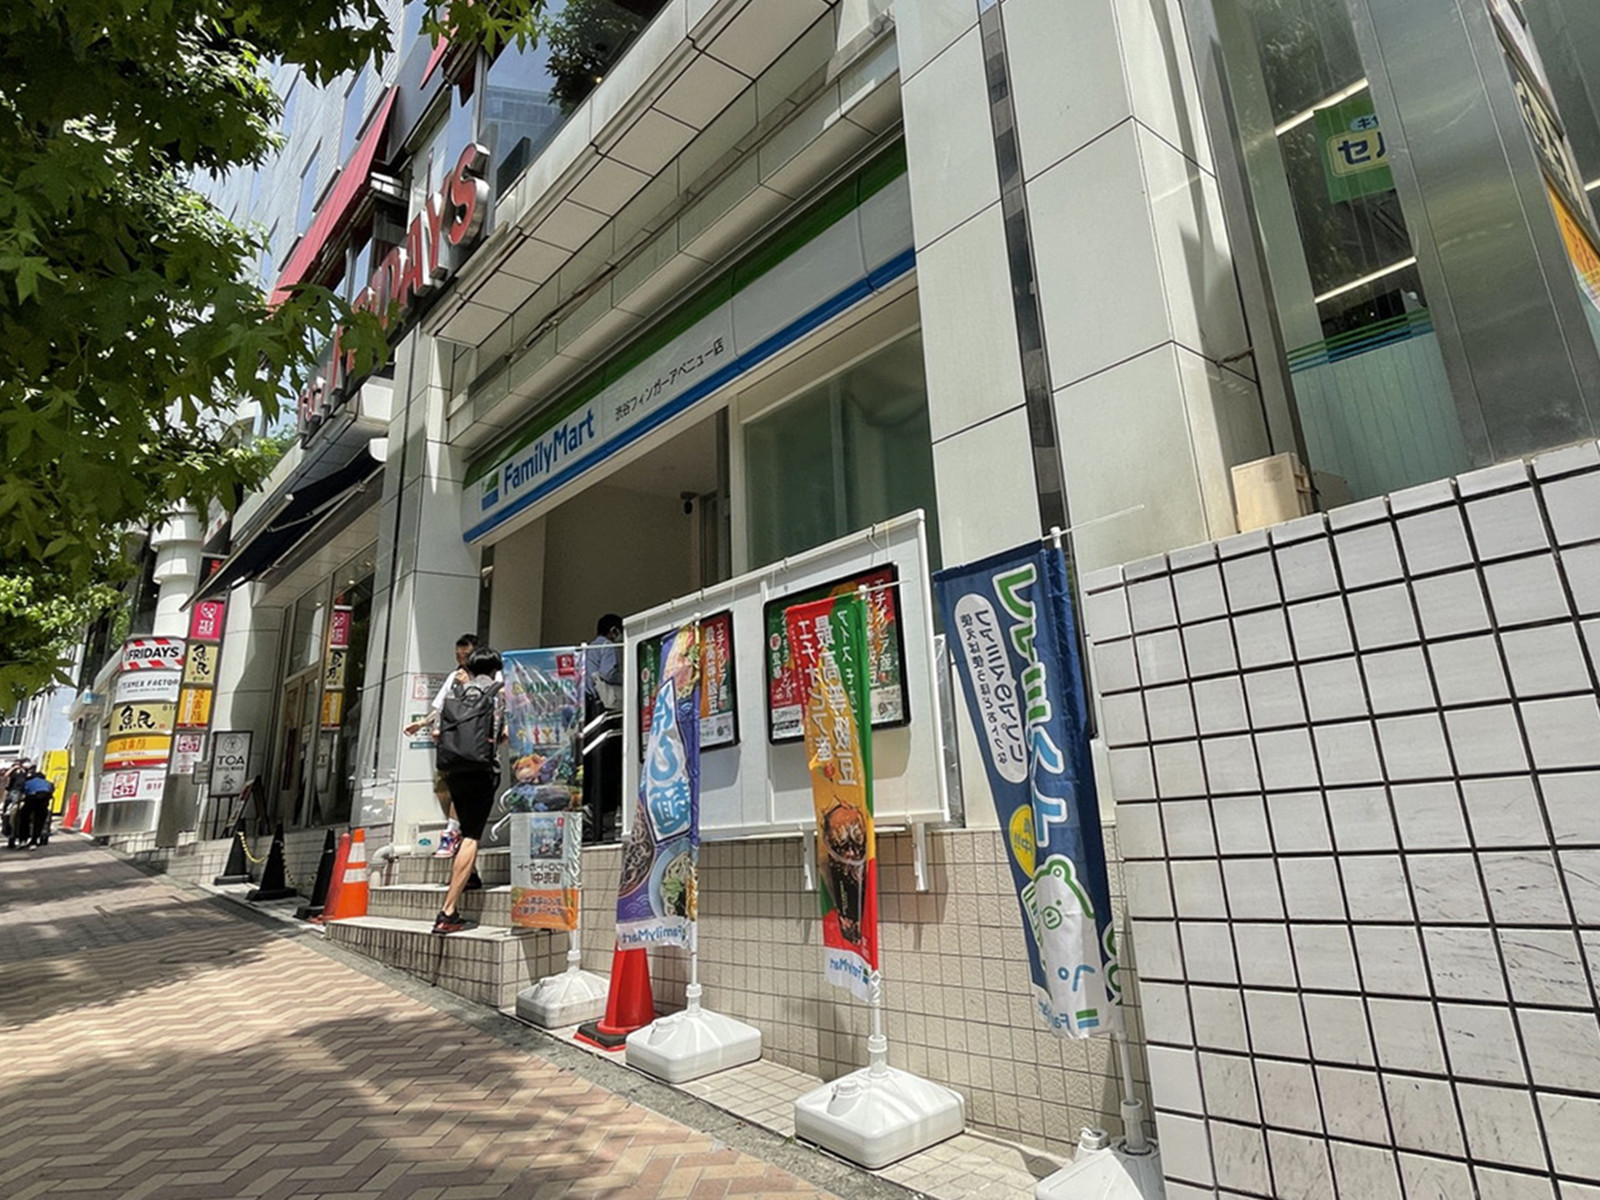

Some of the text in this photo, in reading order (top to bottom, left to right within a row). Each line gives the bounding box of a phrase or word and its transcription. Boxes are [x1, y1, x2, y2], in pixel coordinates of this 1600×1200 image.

[503, 407, 595, 496] FamilyMart
[128, 646, 179, 661] FRIDAYS
[217, 755, 245, 766] TOA
